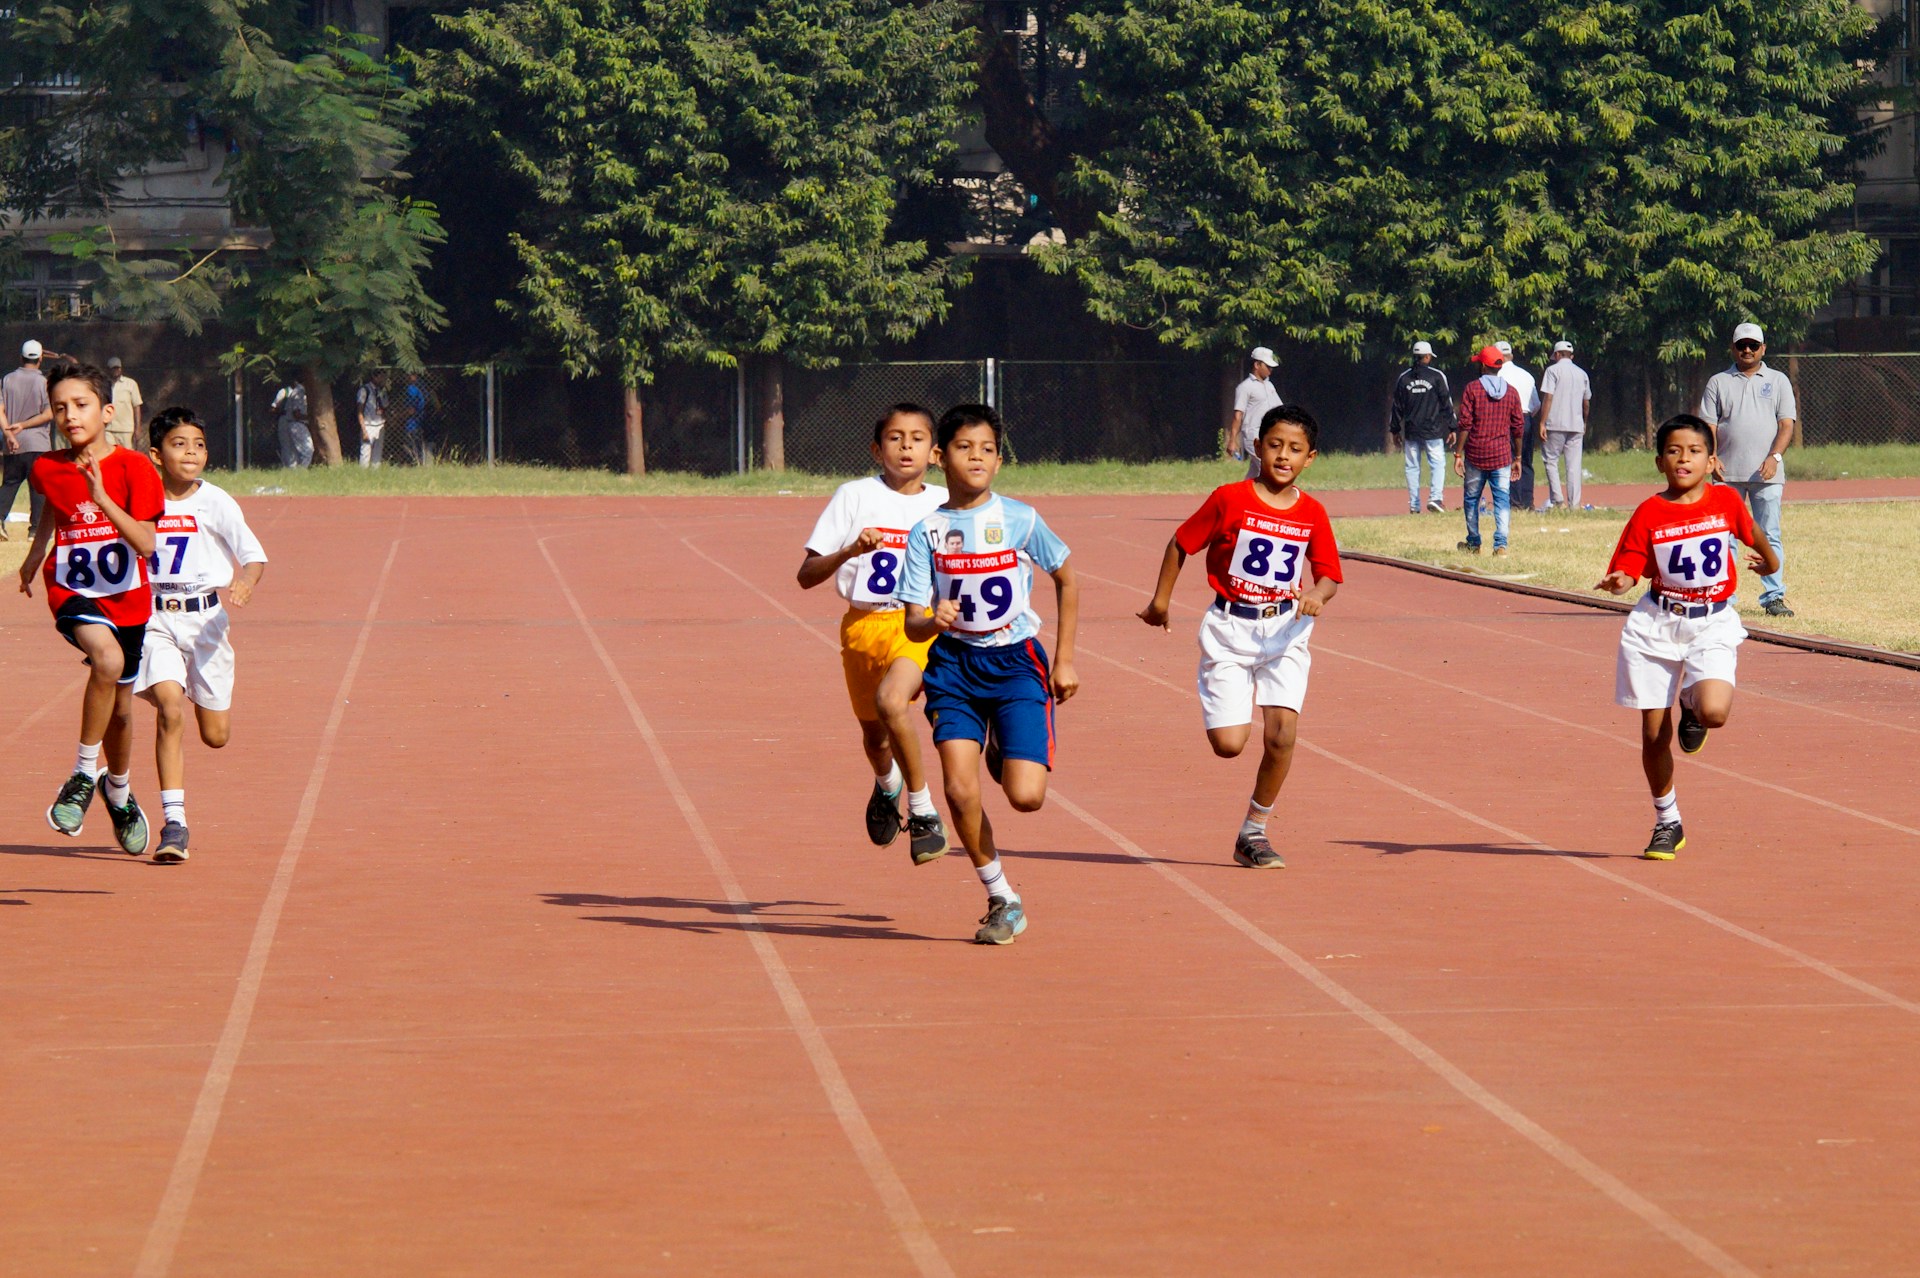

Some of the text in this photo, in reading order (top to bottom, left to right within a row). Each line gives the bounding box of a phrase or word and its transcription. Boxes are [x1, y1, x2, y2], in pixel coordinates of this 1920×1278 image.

[88, 526, 114, 537] SCHOOL
[158, 519, 181, 528] SCHOOL
[1257, 520, 1279, 532] MARY'S
[1279, 525, 1301, 537] SCHOOL
[1665, 526, 1689, 538] MARY'S
[1689, 520, 1713, 534] SCHOOL
[66, 543, 129, 589] 80
[867, 551, 898, 595] 8
[945, 559, 971, 569] MARY'S
[972, 557, 999, 568] SCHOOL
[1242, 537, 1300, 583] 83
[1668, 537, 1722, 581] 48
[950, 576, 1013, 622] 49
